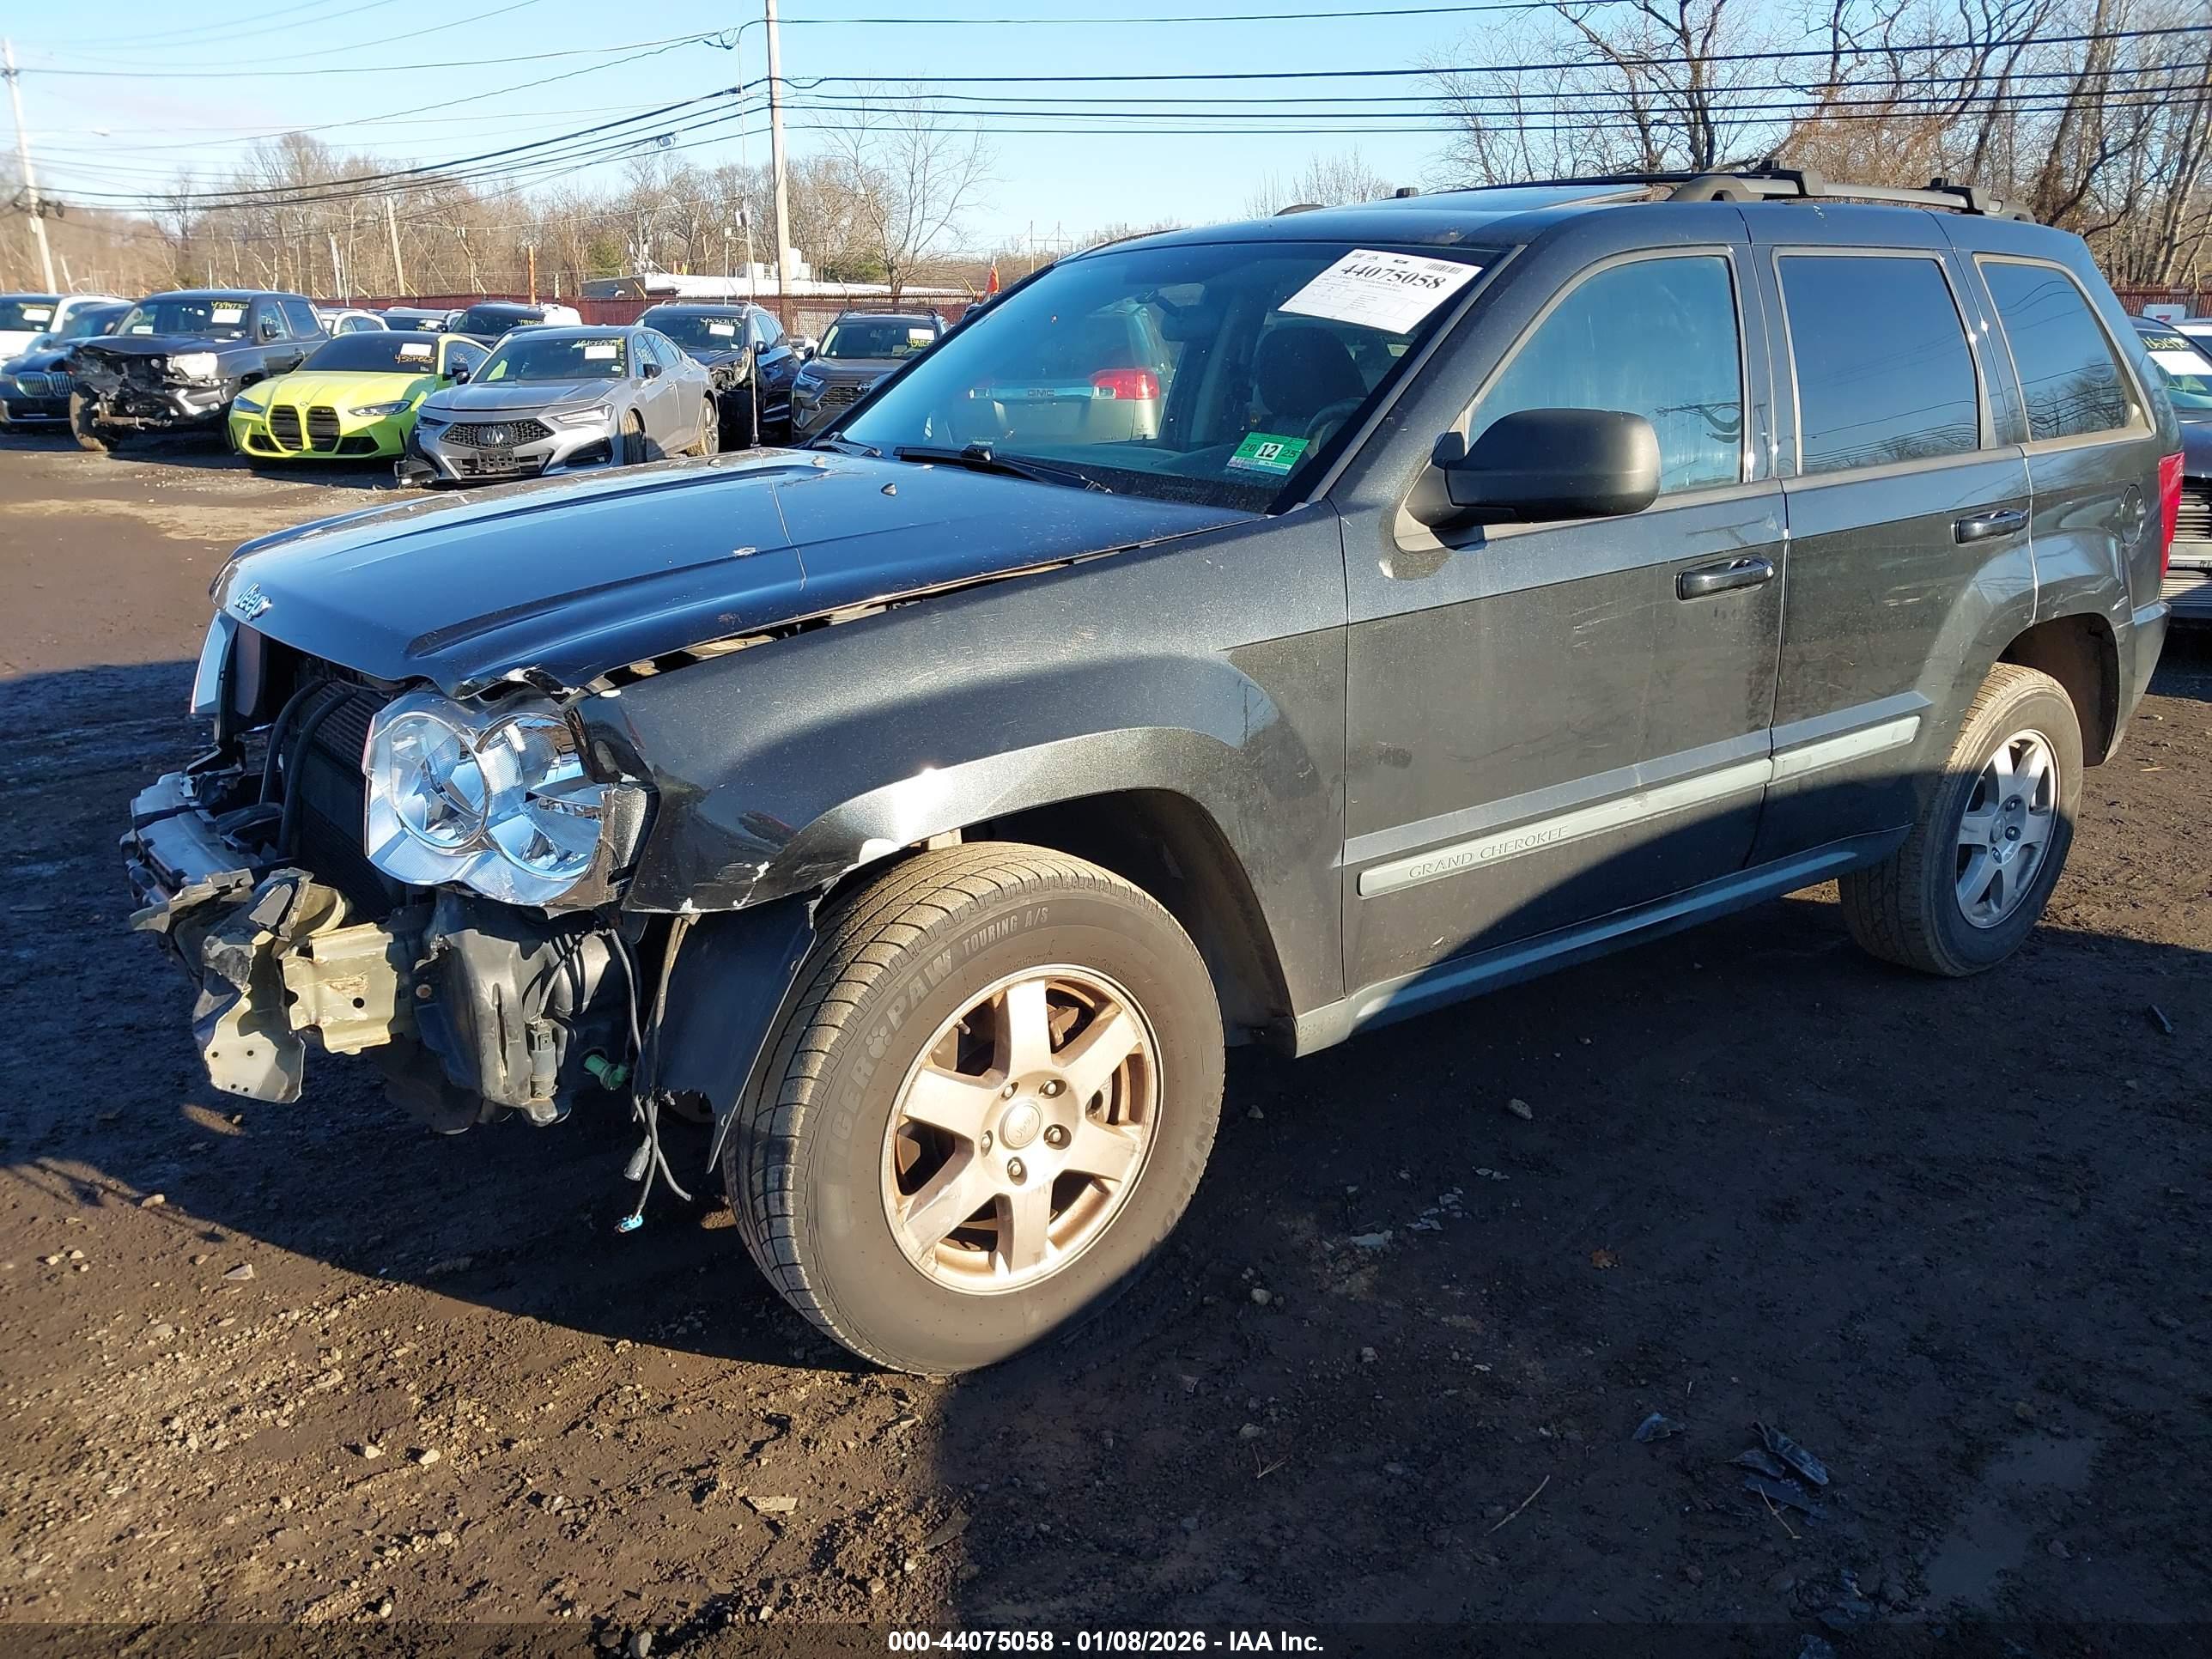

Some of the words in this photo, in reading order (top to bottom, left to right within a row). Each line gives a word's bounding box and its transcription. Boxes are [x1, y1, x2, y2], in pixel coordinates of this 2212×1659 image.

[1340, 264, 1447, 289] 44075058
[1028, 389, 1054, 398] GMC
[1242, 443, 1257, 453] 20
[1258, 443, 1279, 459] 12
[1281, 448, 1297, 459] 25
[234, 582, 272, 620] Jeep
[1408, 851, 1474, 878] GRAND
[1479, 825, 1569, 860] CHEROKEE
[885, 948, 954, 1031] PAW
[961, 914, 1018, 957] TOURING
[1024, 906, 1049, 928] A/S
